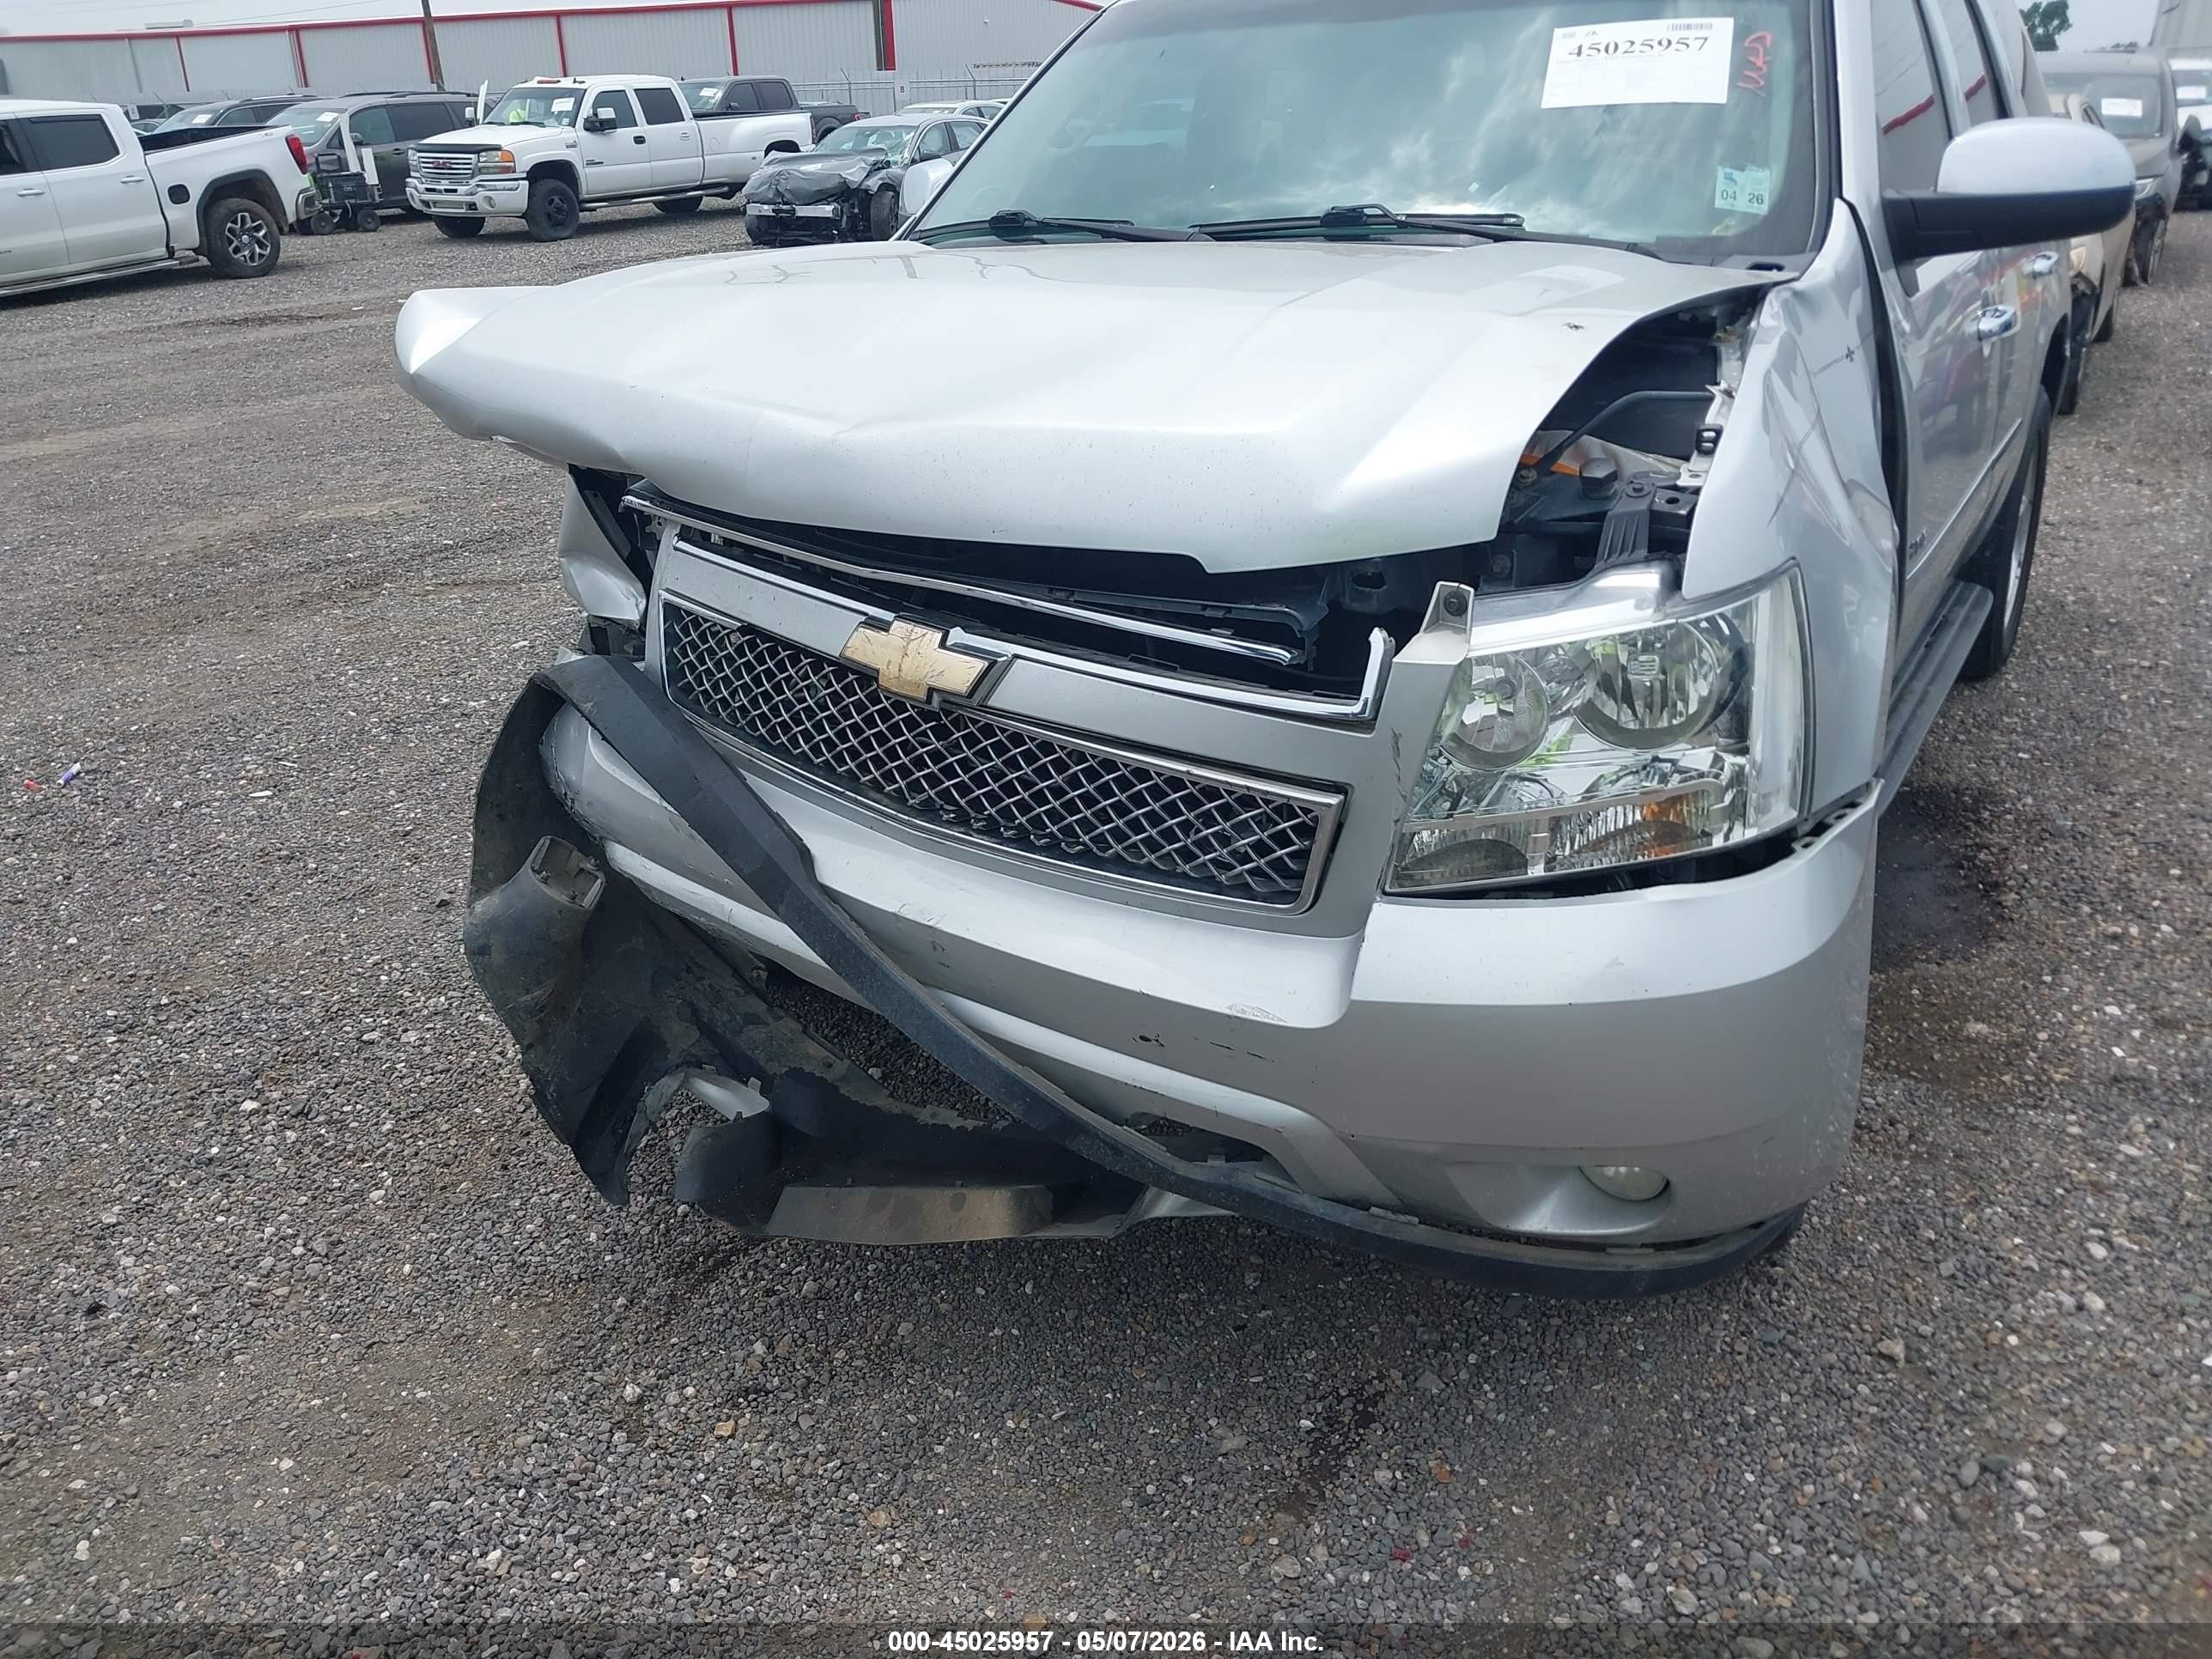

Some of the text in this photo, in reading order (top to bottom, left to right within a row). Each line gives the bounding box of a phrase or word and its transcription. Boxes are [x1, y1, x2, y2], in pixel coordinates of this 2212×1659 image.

[1568, 36, 1709, 58] 45025957
[1721, 189, 1764, 205] 04 26
